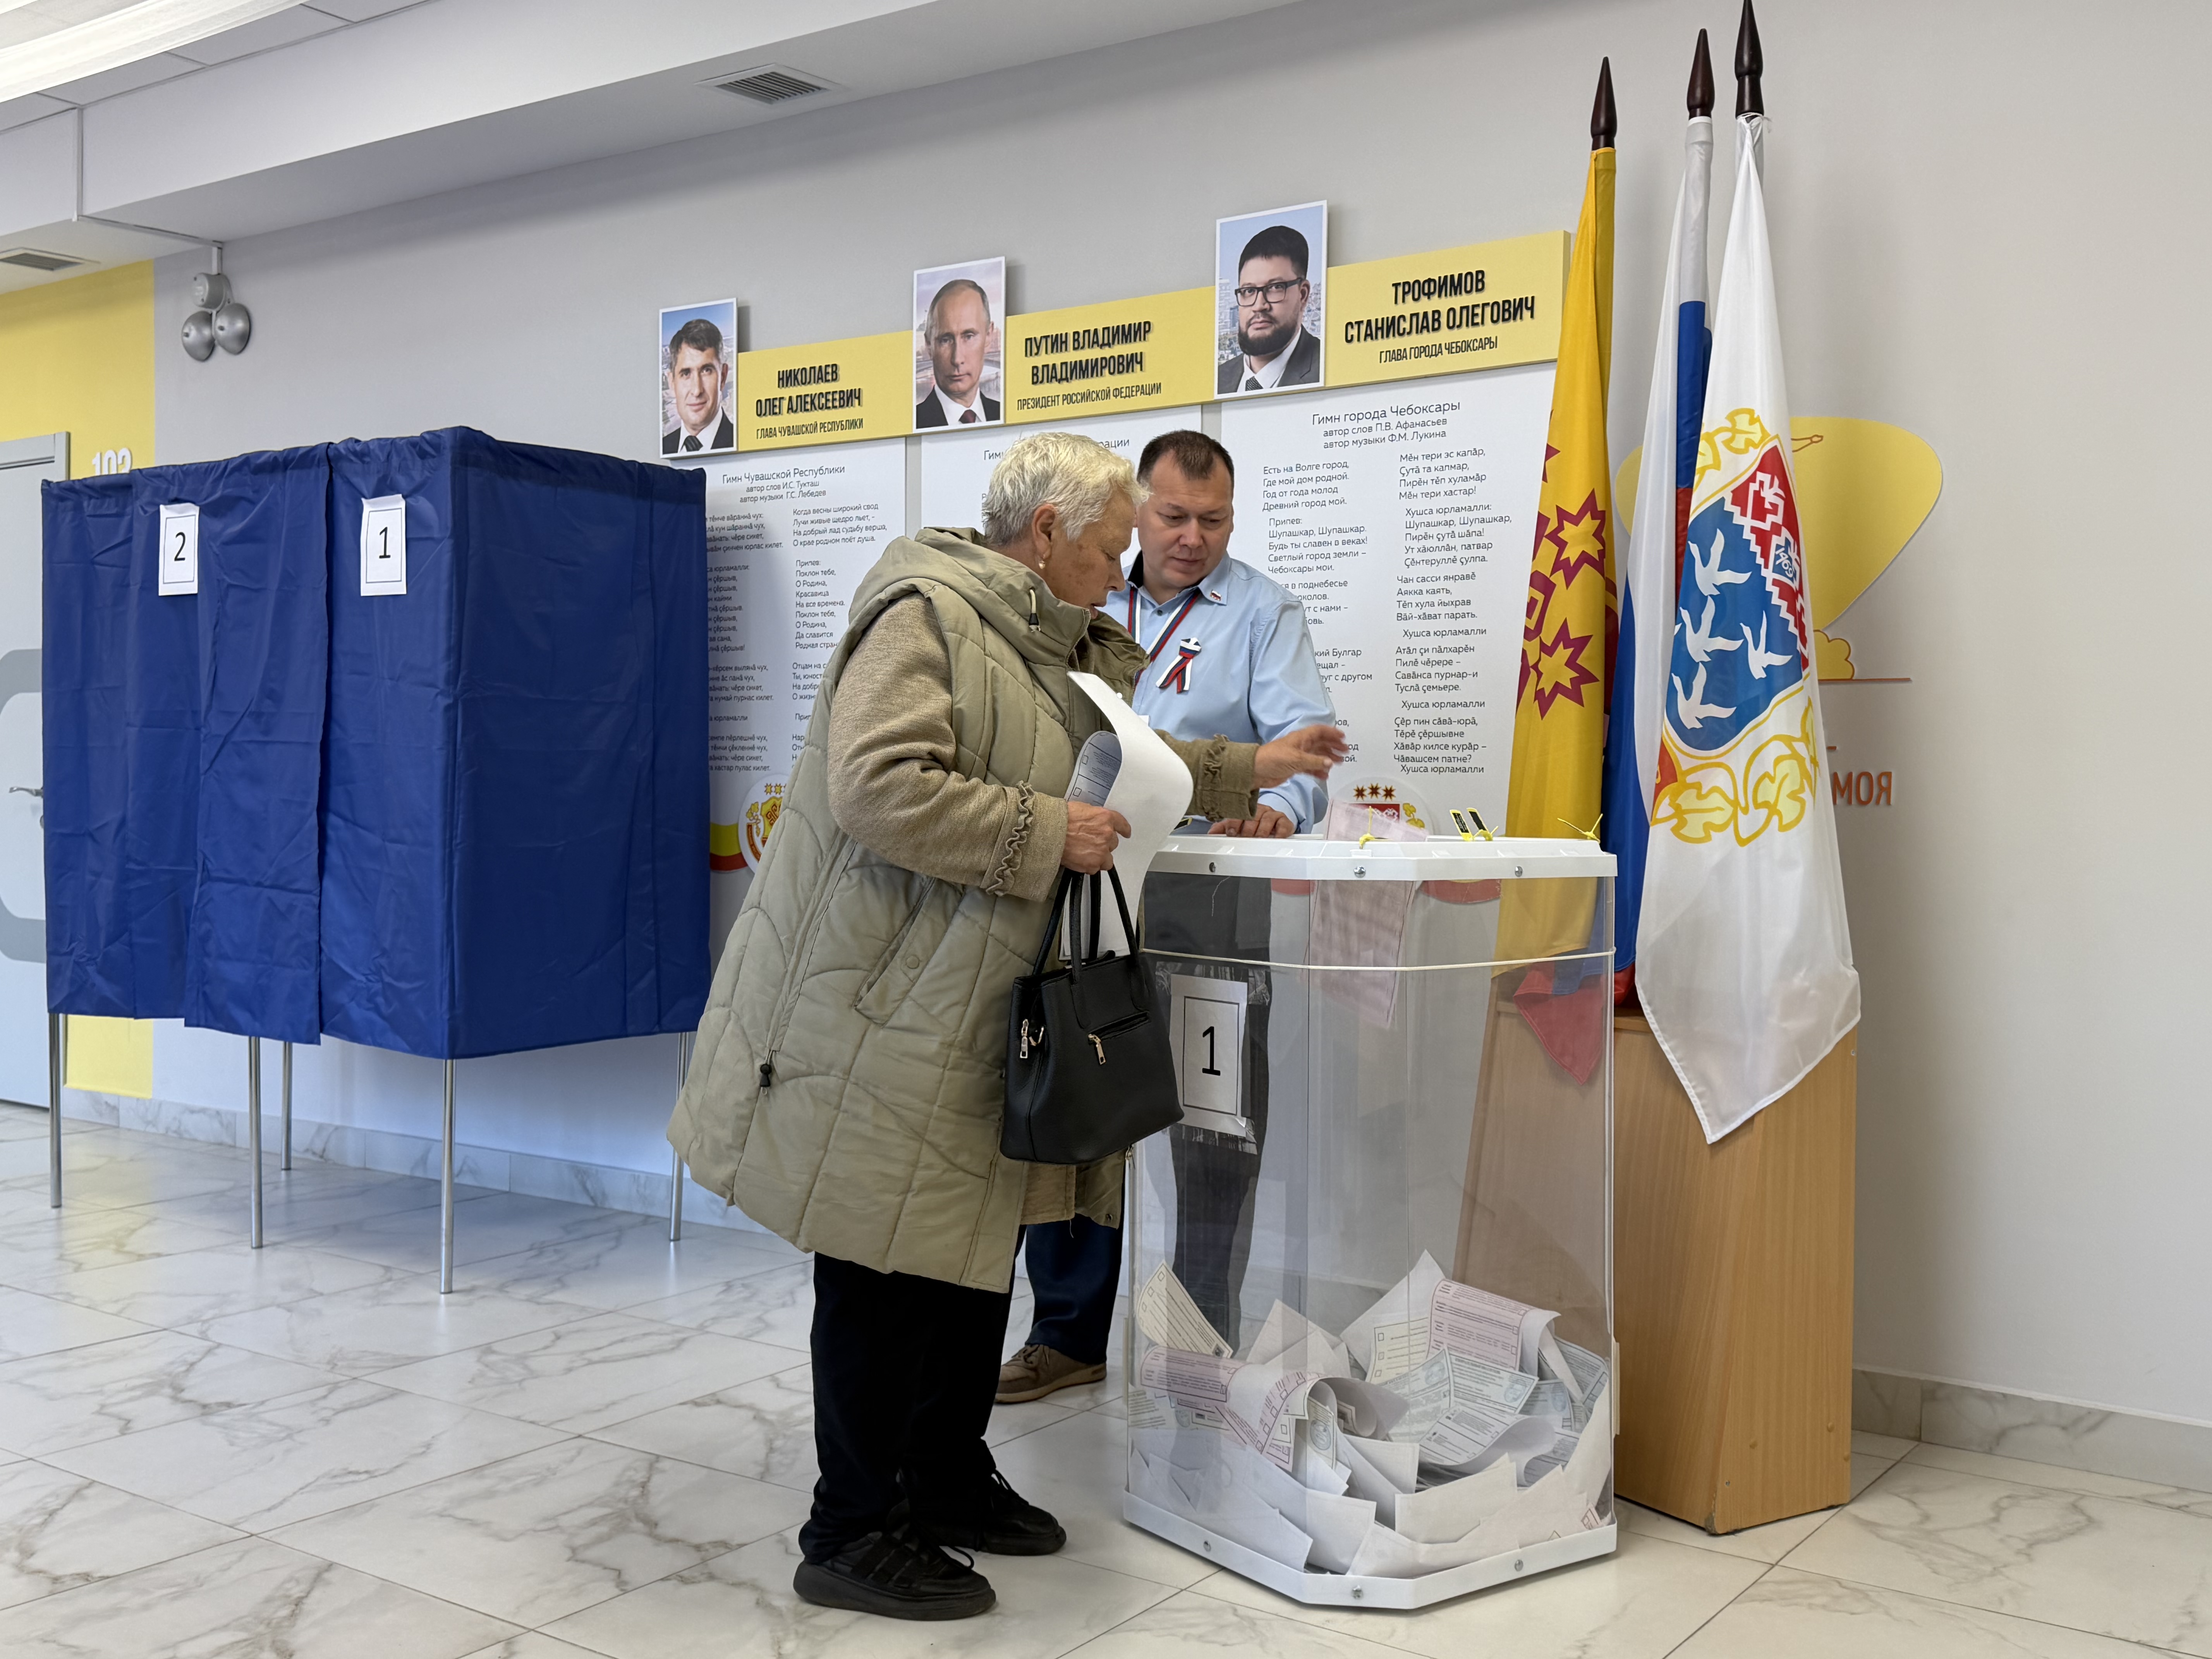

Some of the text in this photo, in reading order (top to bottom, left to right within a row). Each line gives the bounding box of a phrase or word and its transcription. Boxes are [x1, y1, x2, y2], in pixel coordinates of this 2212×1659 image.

[1392, 270, 1485, 304] ТРОФИМОВ
[1345, 296, 1534, 343] СТАНИСЛАВ ОЛЕГОВИЧ
[1025, 321, 1151, 357] ПУТИН ВЛАДИМИР
[1380, 336, 1497, 363] ГЛАВА ГОРОДА ЧЕБОКСАРЫ
[1032, 352, 1142, 385] ВЛАДИМИРОВИЧ
[778, 364, 838, 388] НИКОЛАЕВ
[756, 388, 860, 417] ОЛЕГ АЛЕКСЕЕВИЧ
[1017, 383, 1161, 410] ПРЕЗИДЕНТ РОССИЙСКОЙ ФЕДЕРАЦИИ
[1313, 402, 1460, 425] Гимн города Чебоксары
[757, 418, 863, 439] ГЛАВА ЧУВАШСКОЙ РЕСПУБЛИКИ
[1323, 429, 1349, 437] автор
[1376, 422, 1393, 431] П.В.
[1395, 419, 1447, 431] Афанасьев
[1388, 433, 1408, 442] Ф.М.
[1411, 431, 1446, 442] Лукина
[1421, 453, 1442, 462] тери
[723, 466, 845, 484] Гимн Чувашской Республики
[796, 481, 819, 490] Тукташ
[1264, 479, 1276, 488] Где
[1279, 477, 1294, 485] мой
[1297, 477, 1313, 485] дом
[1263, 491, 1277, 499] Год
[1420, 491, 1441, 500] тери
[1443, 486, 1476, 496] хастар!
[1262, 497, 1347, 512] Древний город мой.
[1406, 504, 1491, 518] Хушса юрламалли:
[1406, 515, 1511, 531] Шупашкар, Шупашкар,
[1269, 529, 1316, 540] Шупашкар,
[174, 532, 186, 561] 2
[379, 527, 391, 559] 1
[1269, 542, 1288, 552] Будь
[1342, 536, 1367, 545] веках!
[1405, 546, 1415, 554] Ут
[1461, 543, 1492, 551] патвар
[1268, 553, 1303, 562] Светлый
[1306, 553, 1331, 562] город
[1268, 566, 1314, 574] Чебоксары
[1298, 580, 1348, 589] поднебесье
[1397, 575, 1413, 584] Чан
[1397, 588, 1424, 596] Аякка
[1415, 601, 1435, 610] хула
[1438, 599, 1471, 608] йыхрав
[1444, 612, 1477, 621] парать.
[1403, 629, 1486, 639] Хушса юрламалли
[1333, 648, 1362, 658] Булгар
[1341, 674, 1372, 683] другом
[1401, 701, 1485, 711] Хушса юрламалли
[1442, 754, 1472, 763] патне?
[1400, 764, 1484, 775] Хушса юрламалли
[1832, 771, 1892, 805] МОЯ
[1202, 1026, 1221, 1076] 1
